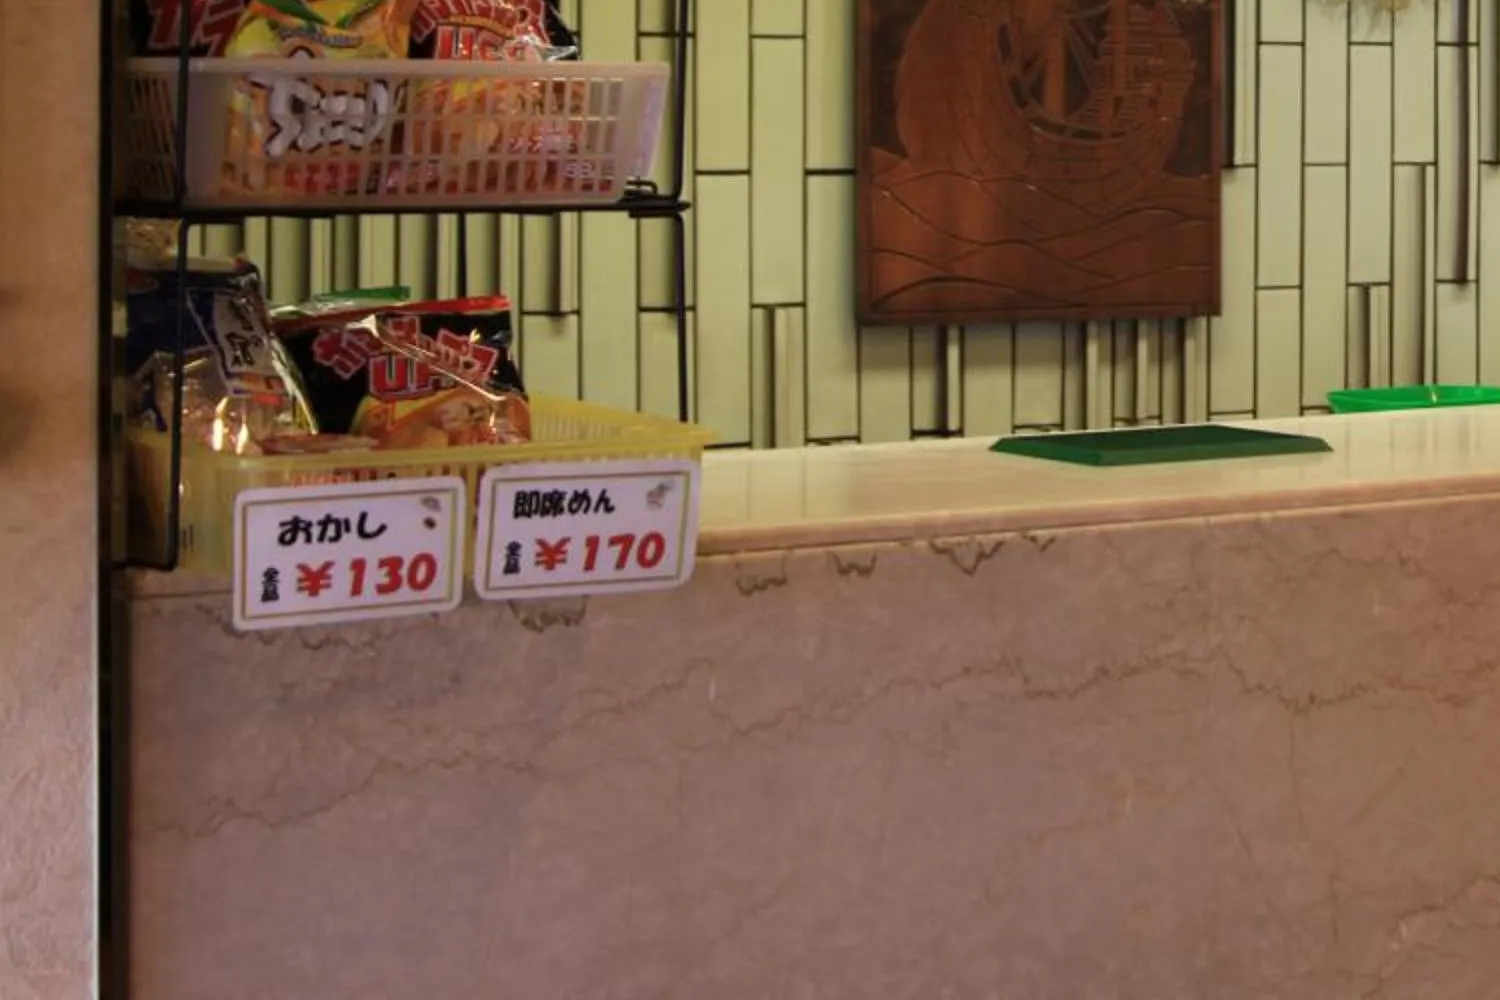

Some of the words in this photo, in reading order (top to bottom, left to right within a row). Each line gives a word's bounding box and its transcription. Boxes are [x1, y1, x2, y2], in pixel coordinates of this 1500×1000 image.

[513, 488, 615, 519] 即席めん
[277, 511, 388, 547] おかし
[534, 531, 666, 572] ¥170
[296, 552, 437, 598] ¥130
